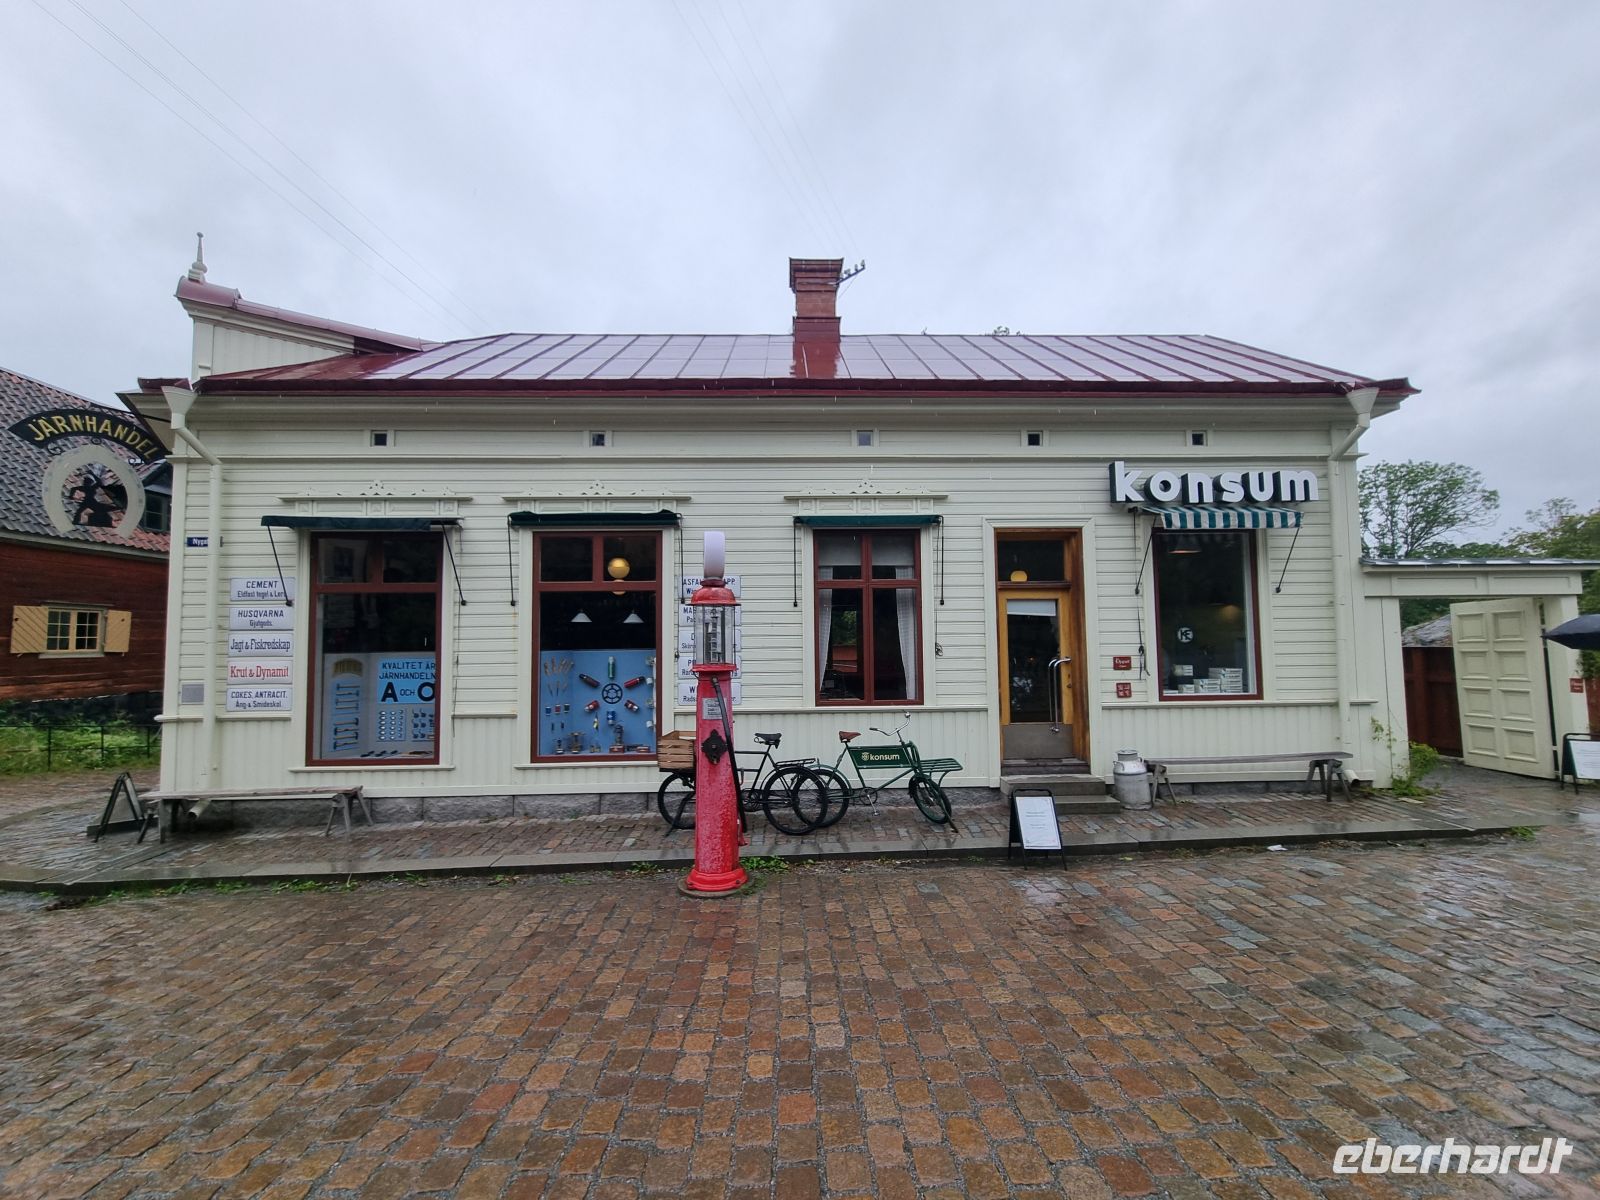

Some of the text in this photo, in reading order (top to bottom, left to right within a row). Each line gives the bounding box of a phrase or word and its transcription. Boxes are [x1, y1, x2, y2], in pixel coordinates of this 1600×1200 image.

[28, 414, 157, 459] JÄRNHANDEL
[1111, 460, 1319, 503] konsum
[246, 581, 279, 589] CEMENT
[237, 610, 284, 618] HUSQVARNA
[250, 638, 291, 653] Fiskredskap
[230, 665, 248, 678] Krut
[255, 665, 289, 680] Dynamit
[382, 661, 423, 670] KVALITET
[381, 681, 399, 703] A
[399, 688, 416, 697] OCH
[870, 753, 900, 761] konsum
